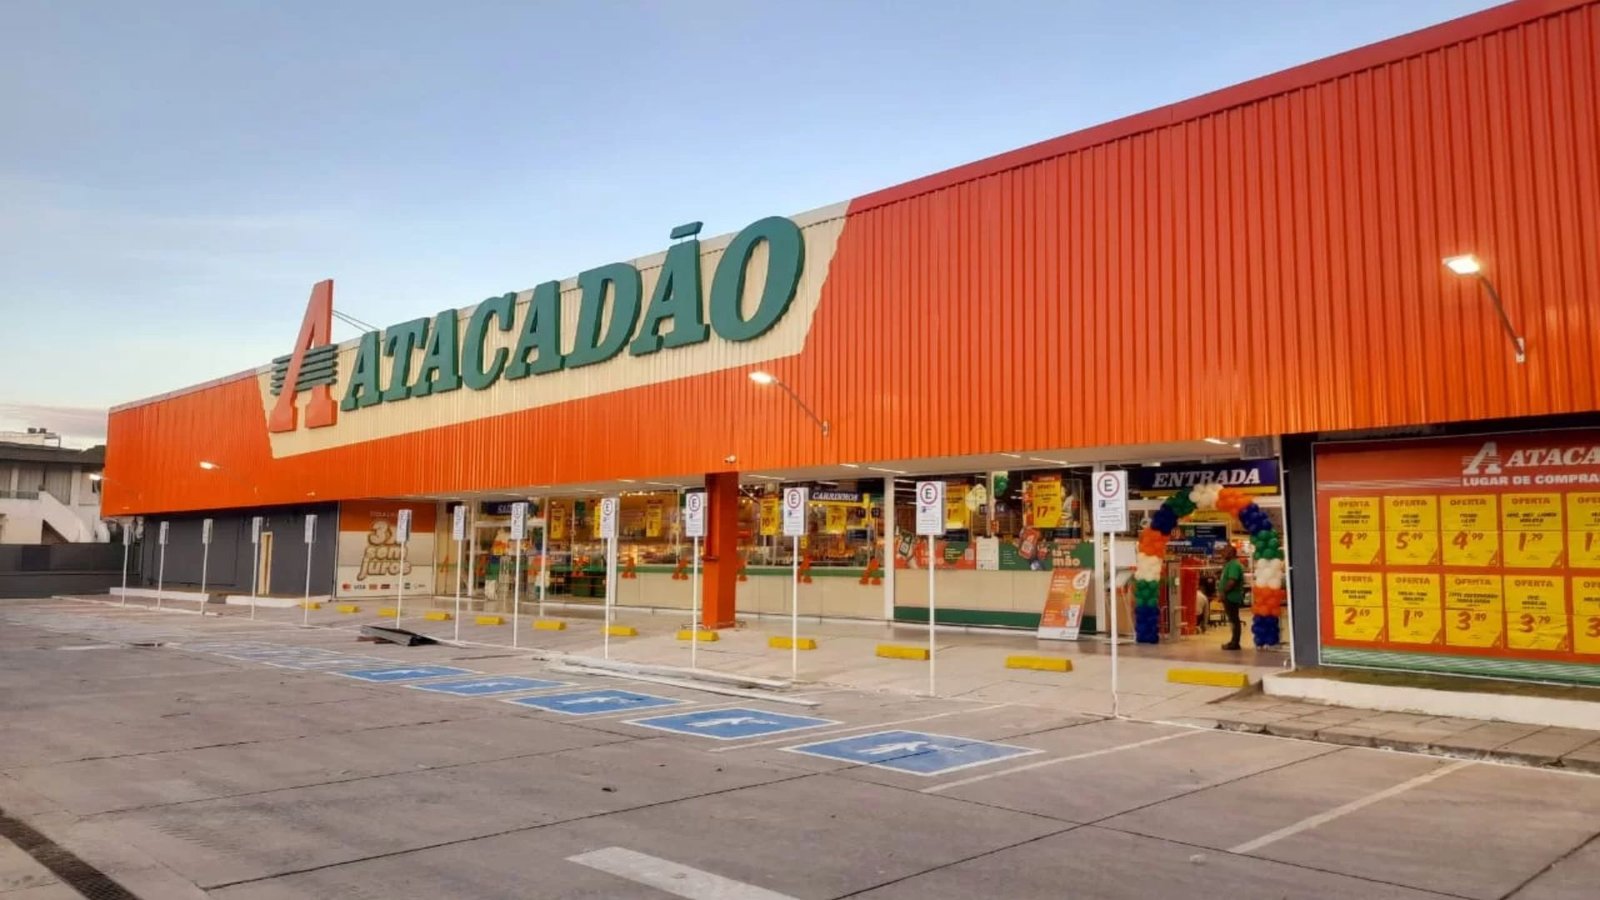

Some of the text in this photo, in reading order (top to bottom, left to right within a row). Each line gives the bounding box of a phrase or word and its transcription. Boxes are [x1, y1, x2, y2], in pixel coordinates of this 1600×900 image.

[340, 215, 806, 412] ATACADÃO
[1152, 467, 1261, 488] ENTRADA
[1462, 476, 1509, 487] LUGAR
[1512, 475, 1531, 486] DE
[1104, 479, 1113, 492] E
[924, 488, 932, 499] E
[791, 494, 797, 504] E
[1338, 500, 1371, 508] OFERTA
[1392, 499, 1428, 507] OFERTA
[1450, 498, 1487, 506] OFERTA
[1511, 496, 1551, 506] OFERTA
[366, 546, 408, 560] sem
[1052, 555, 1081, 567] mão
[357, 557, 412, 581] juros
[1340, 575, 1374, 583] OFERTA
[1395, 576, 1430, 585] OFERTA
[1454, 577, 1492, 586] OFERTA
[1514, 579, 1554, 588] OFERTA
